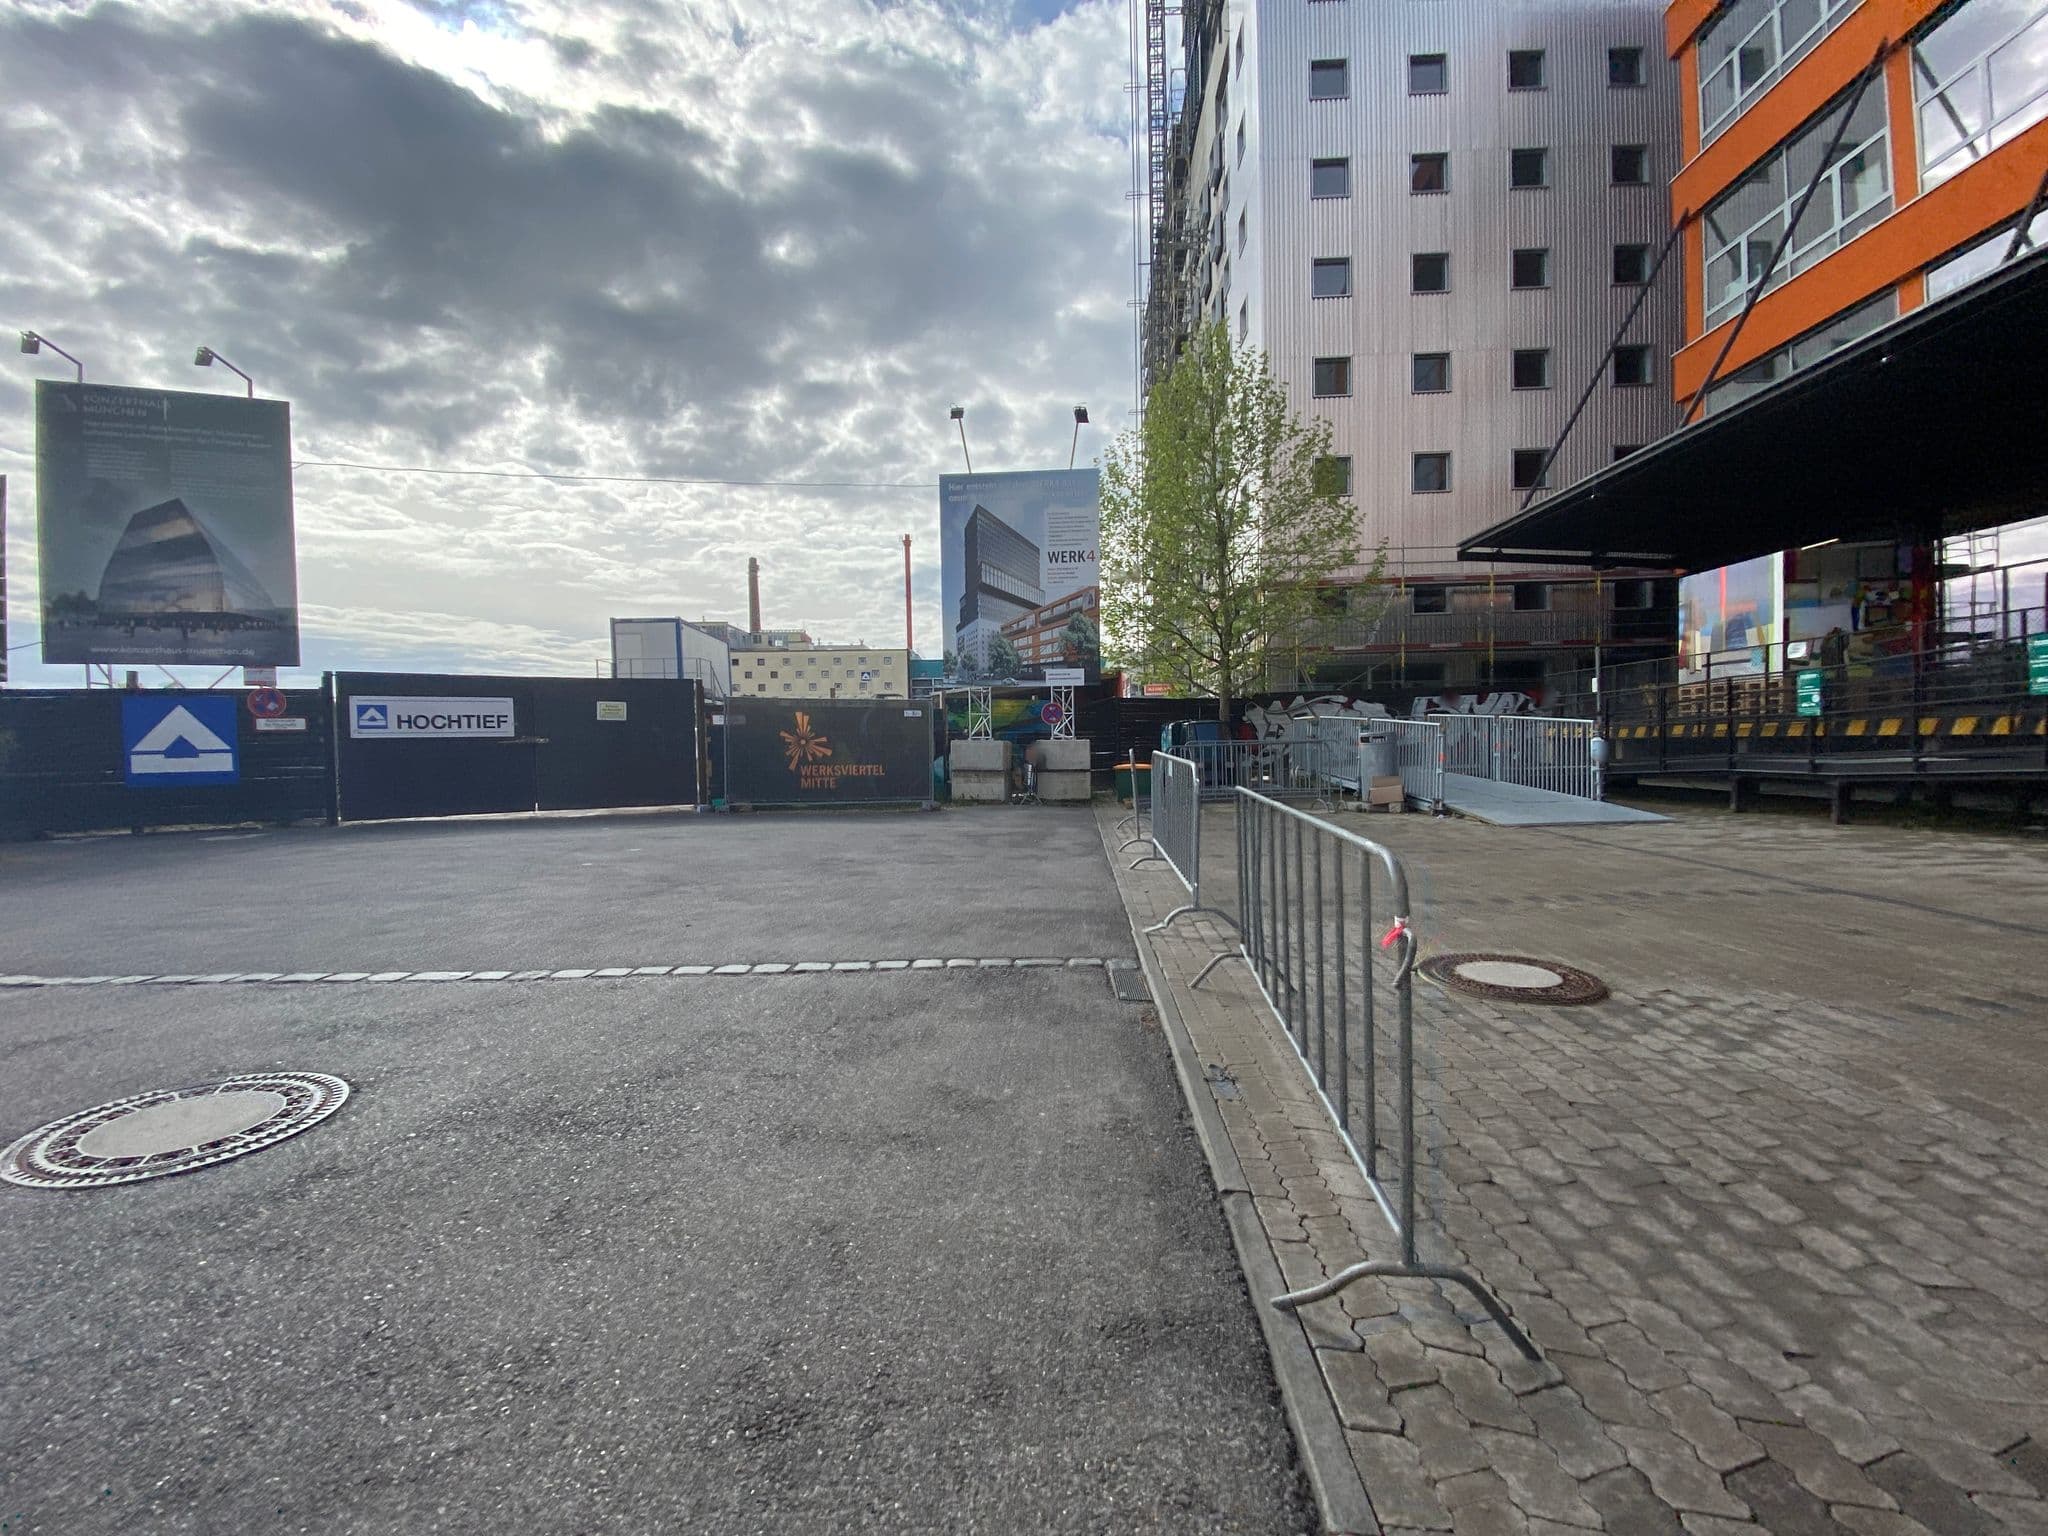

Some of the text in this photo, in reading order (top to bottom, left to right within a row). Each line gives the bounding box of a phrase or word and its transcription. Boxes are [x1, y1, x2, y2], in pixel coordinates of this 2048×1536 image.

[1047, 550, 1096, 564] WERK4
[396, 714, 508, 730] HOCHTIEF
[799, 764, 886, 777] WERKSVIERTEL
[799, 776, 837, 790] MITTE
